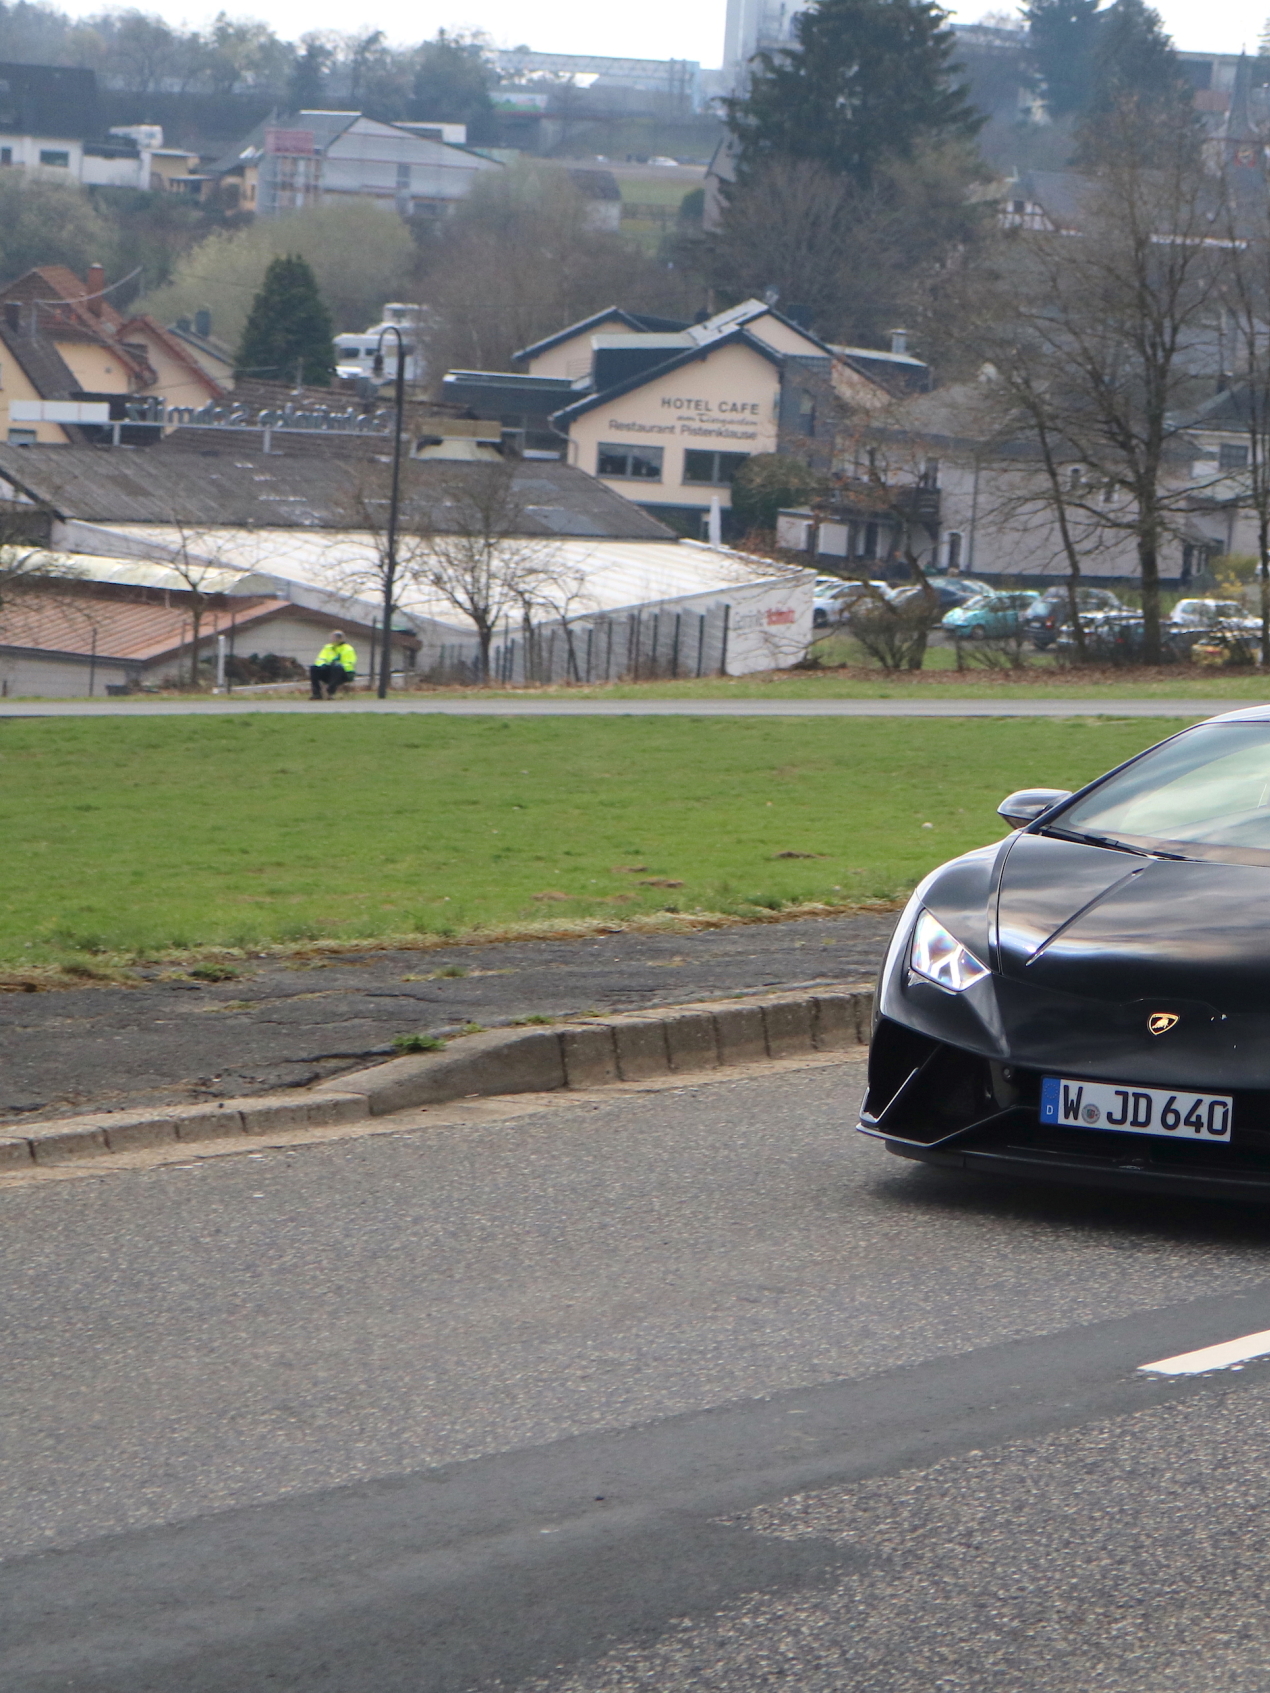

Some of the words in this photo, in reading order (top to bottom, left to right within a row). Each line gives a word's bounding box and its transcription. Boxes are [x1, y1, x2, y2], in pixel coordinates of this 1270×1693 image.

[660, 397, 713, 412] HOTEL
[718, 401, 759, 415] CAFE
[608, 418, 676, 435] Restaurant
[679, 423, 758, 441] Pistenklause
[1045, 1104, 1054, 1116] D
[1063, 1084, 1084, 1121] W
[1106, 1089, 1153, 1129] JD
[1160, 1095, 1230, 1137] 640
